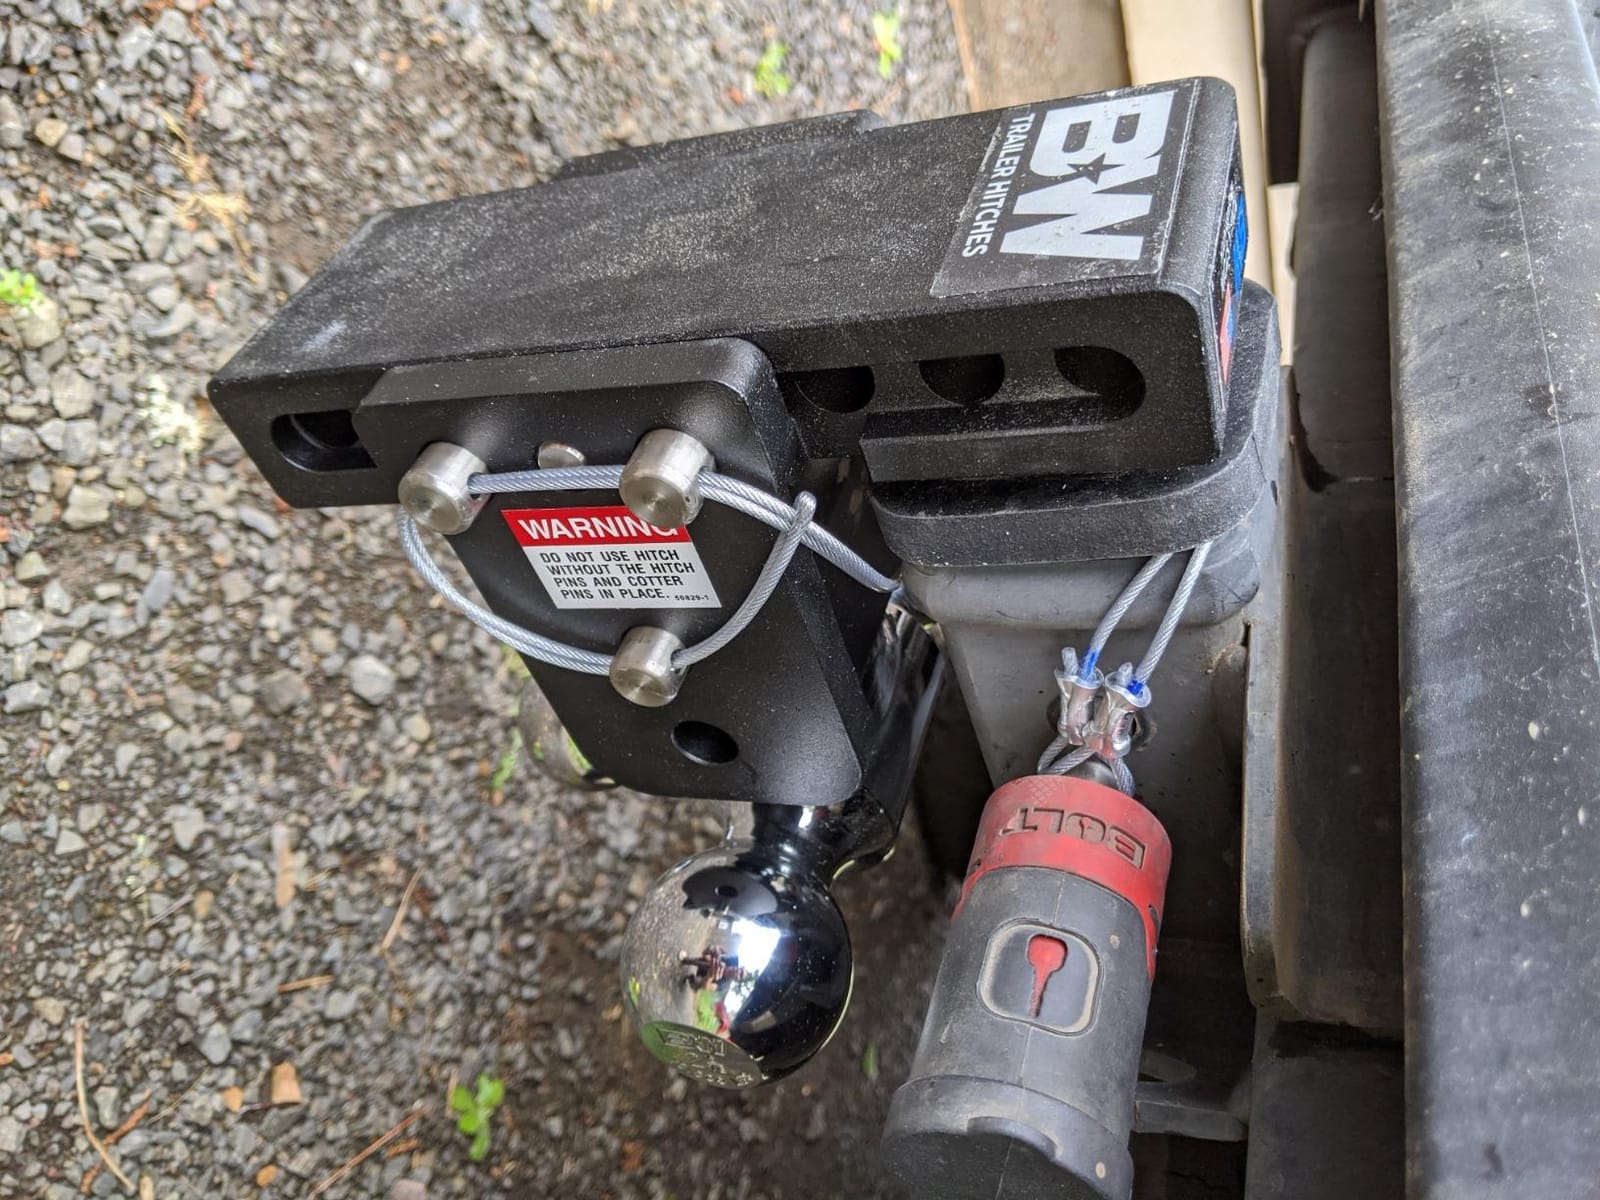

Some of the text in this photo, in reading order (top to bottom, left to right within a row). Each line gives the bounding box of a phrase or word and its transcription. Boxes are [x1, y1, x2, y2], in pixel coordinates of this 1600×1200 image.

[961, 113, 1036, 258] TRAILER HITCHES
[540, 549, 680, 563] DO NOT USE HITCH
[546, 562, 696, 576] WITHOUT THE HITCH
[553, 575, 684, 588] PINS AND COTTER
[560, 588, 670, 600] PINS IN PLACE.
[999, 807, 1146, 870] BOLT
